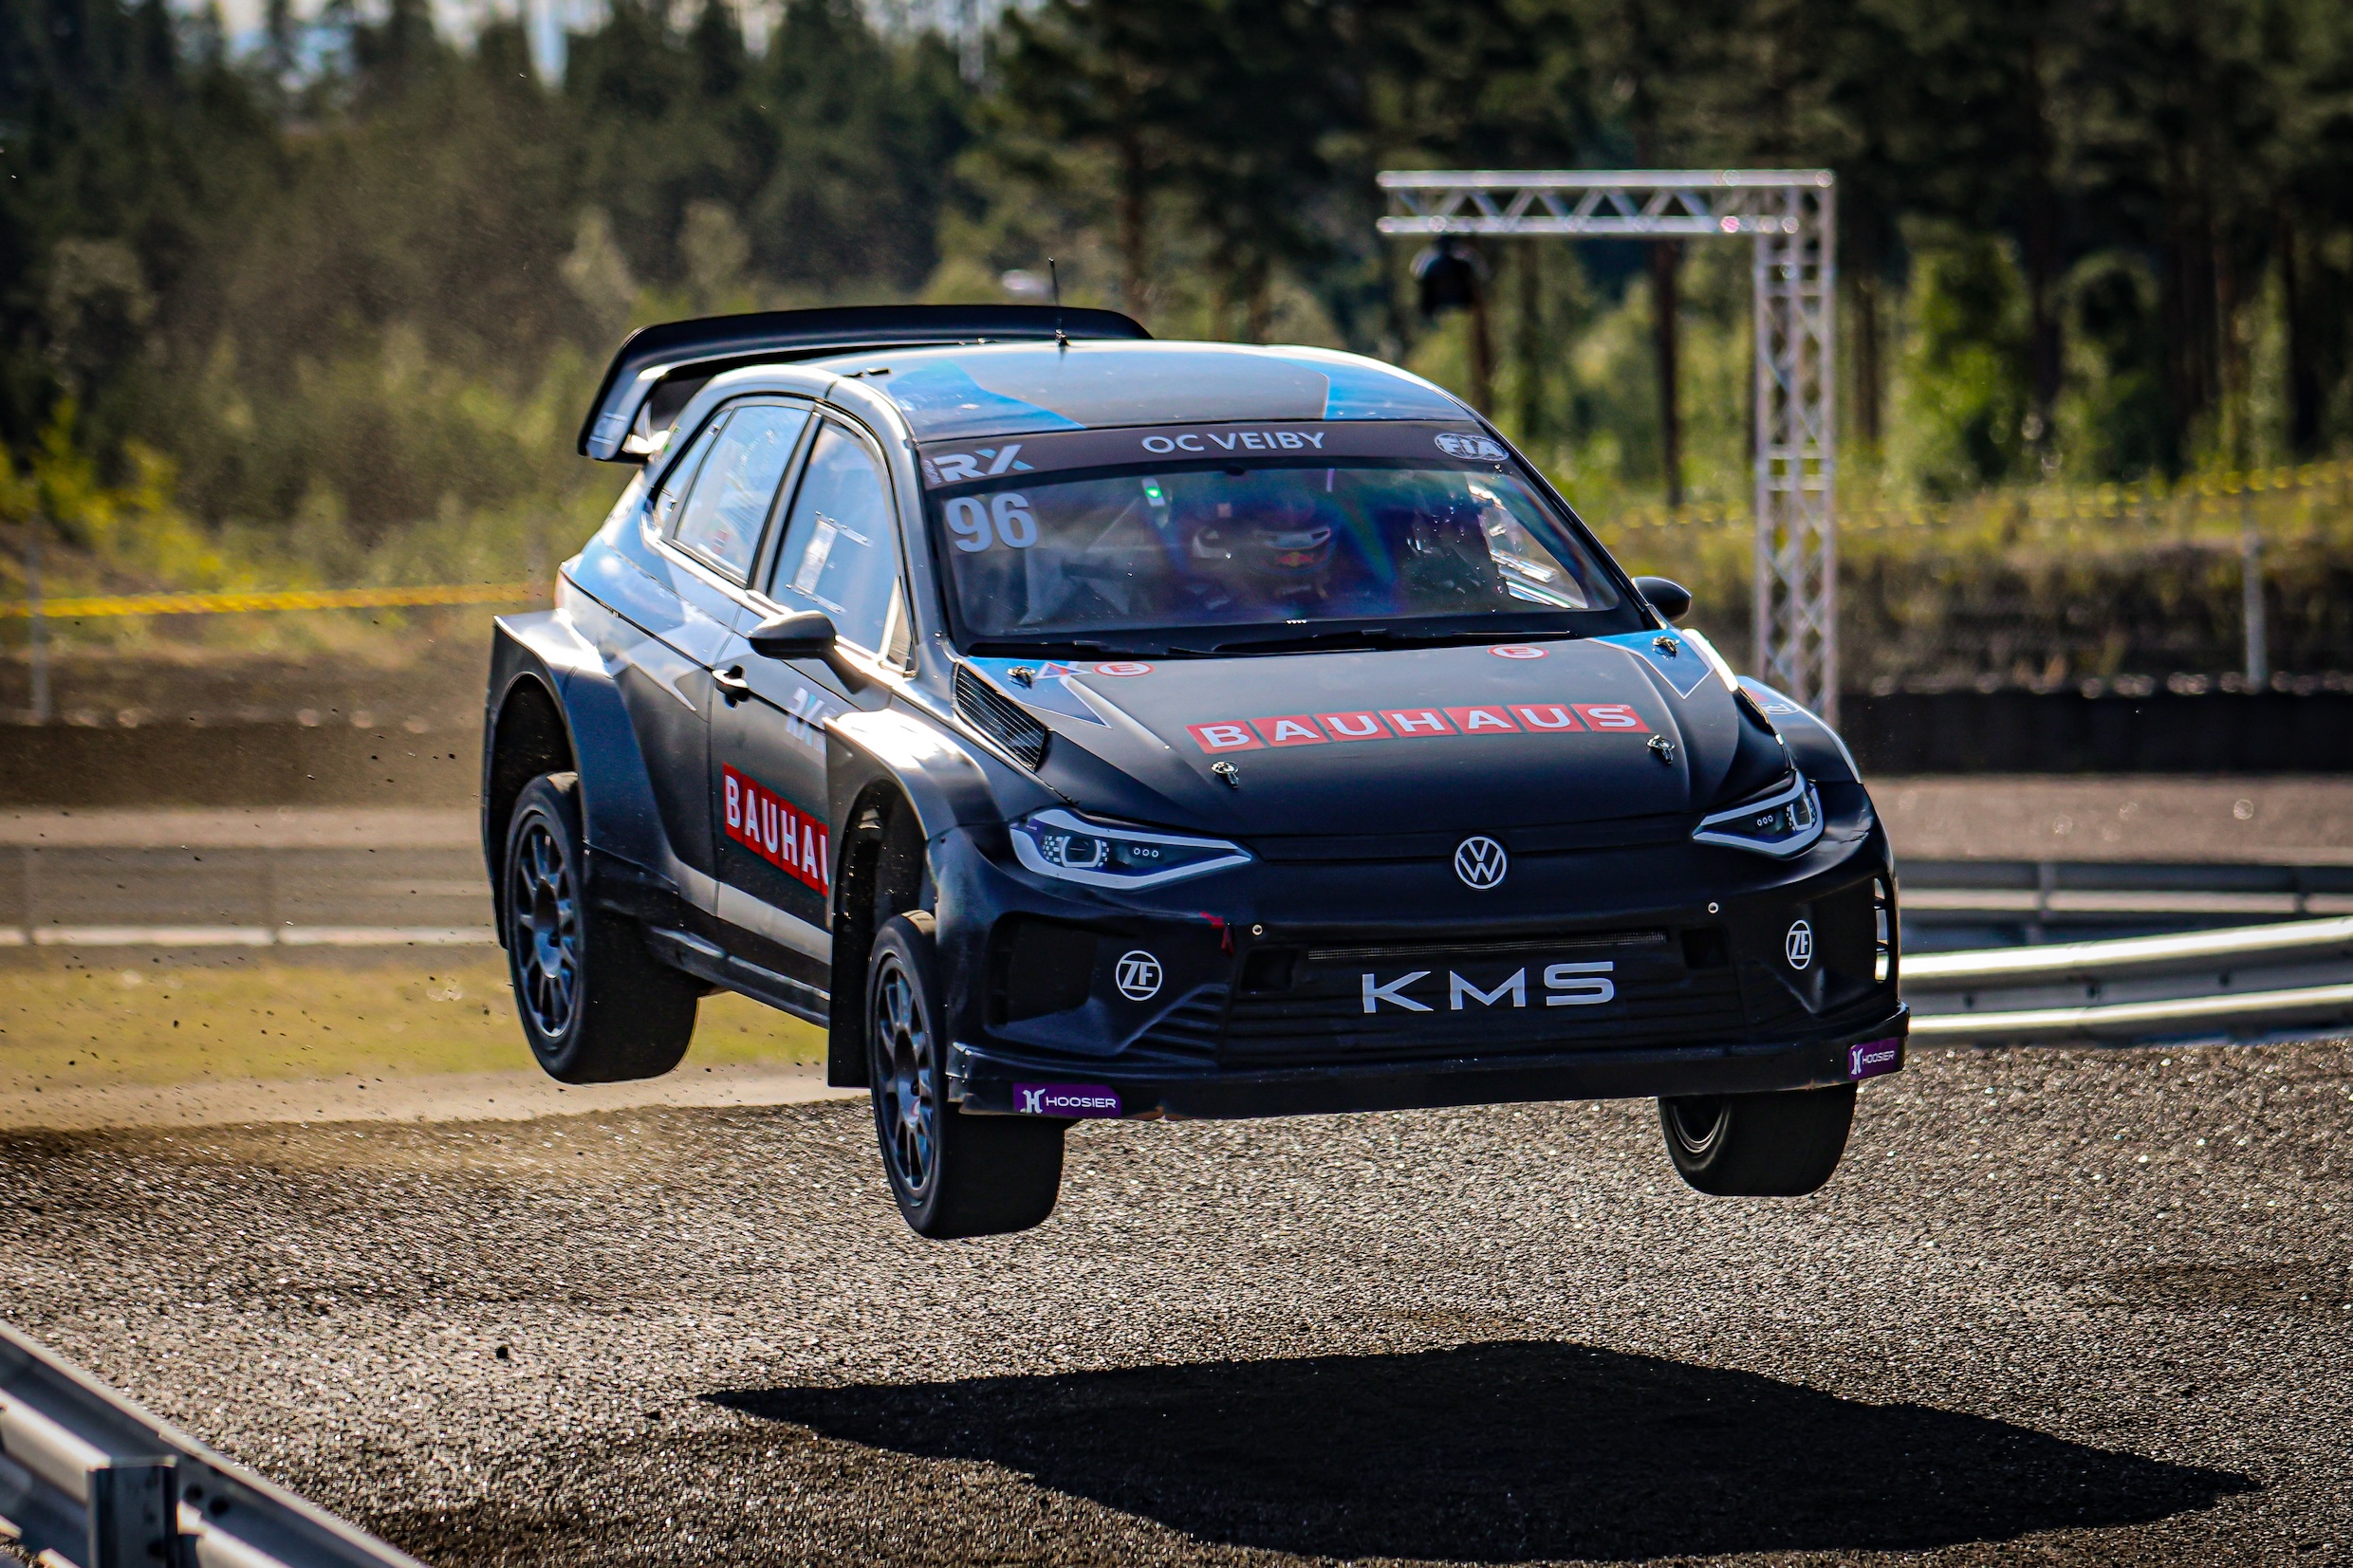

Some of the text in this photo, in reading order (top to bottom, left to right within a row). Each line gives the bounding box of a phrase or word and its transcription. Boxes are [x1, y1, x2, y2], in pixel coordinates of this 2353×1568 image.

[1141, 432, 1325, 453] OC VEIBY
[1437, 435, 1506, 458] FIA
[932, 444, 1035, 482] RX
[946, 492, 1038, 552] 96
[1199, 706, 1637, 748] BAUHAUS
[1454, 837, 1507, 889] VW
[1788, 927, 1810, 962] ZF
[1119, 958, 1160, 993] ZF
[1362, 961, 1614, 1013] KMS
[1046, 1097, 1116, 1108] HOOSIER
